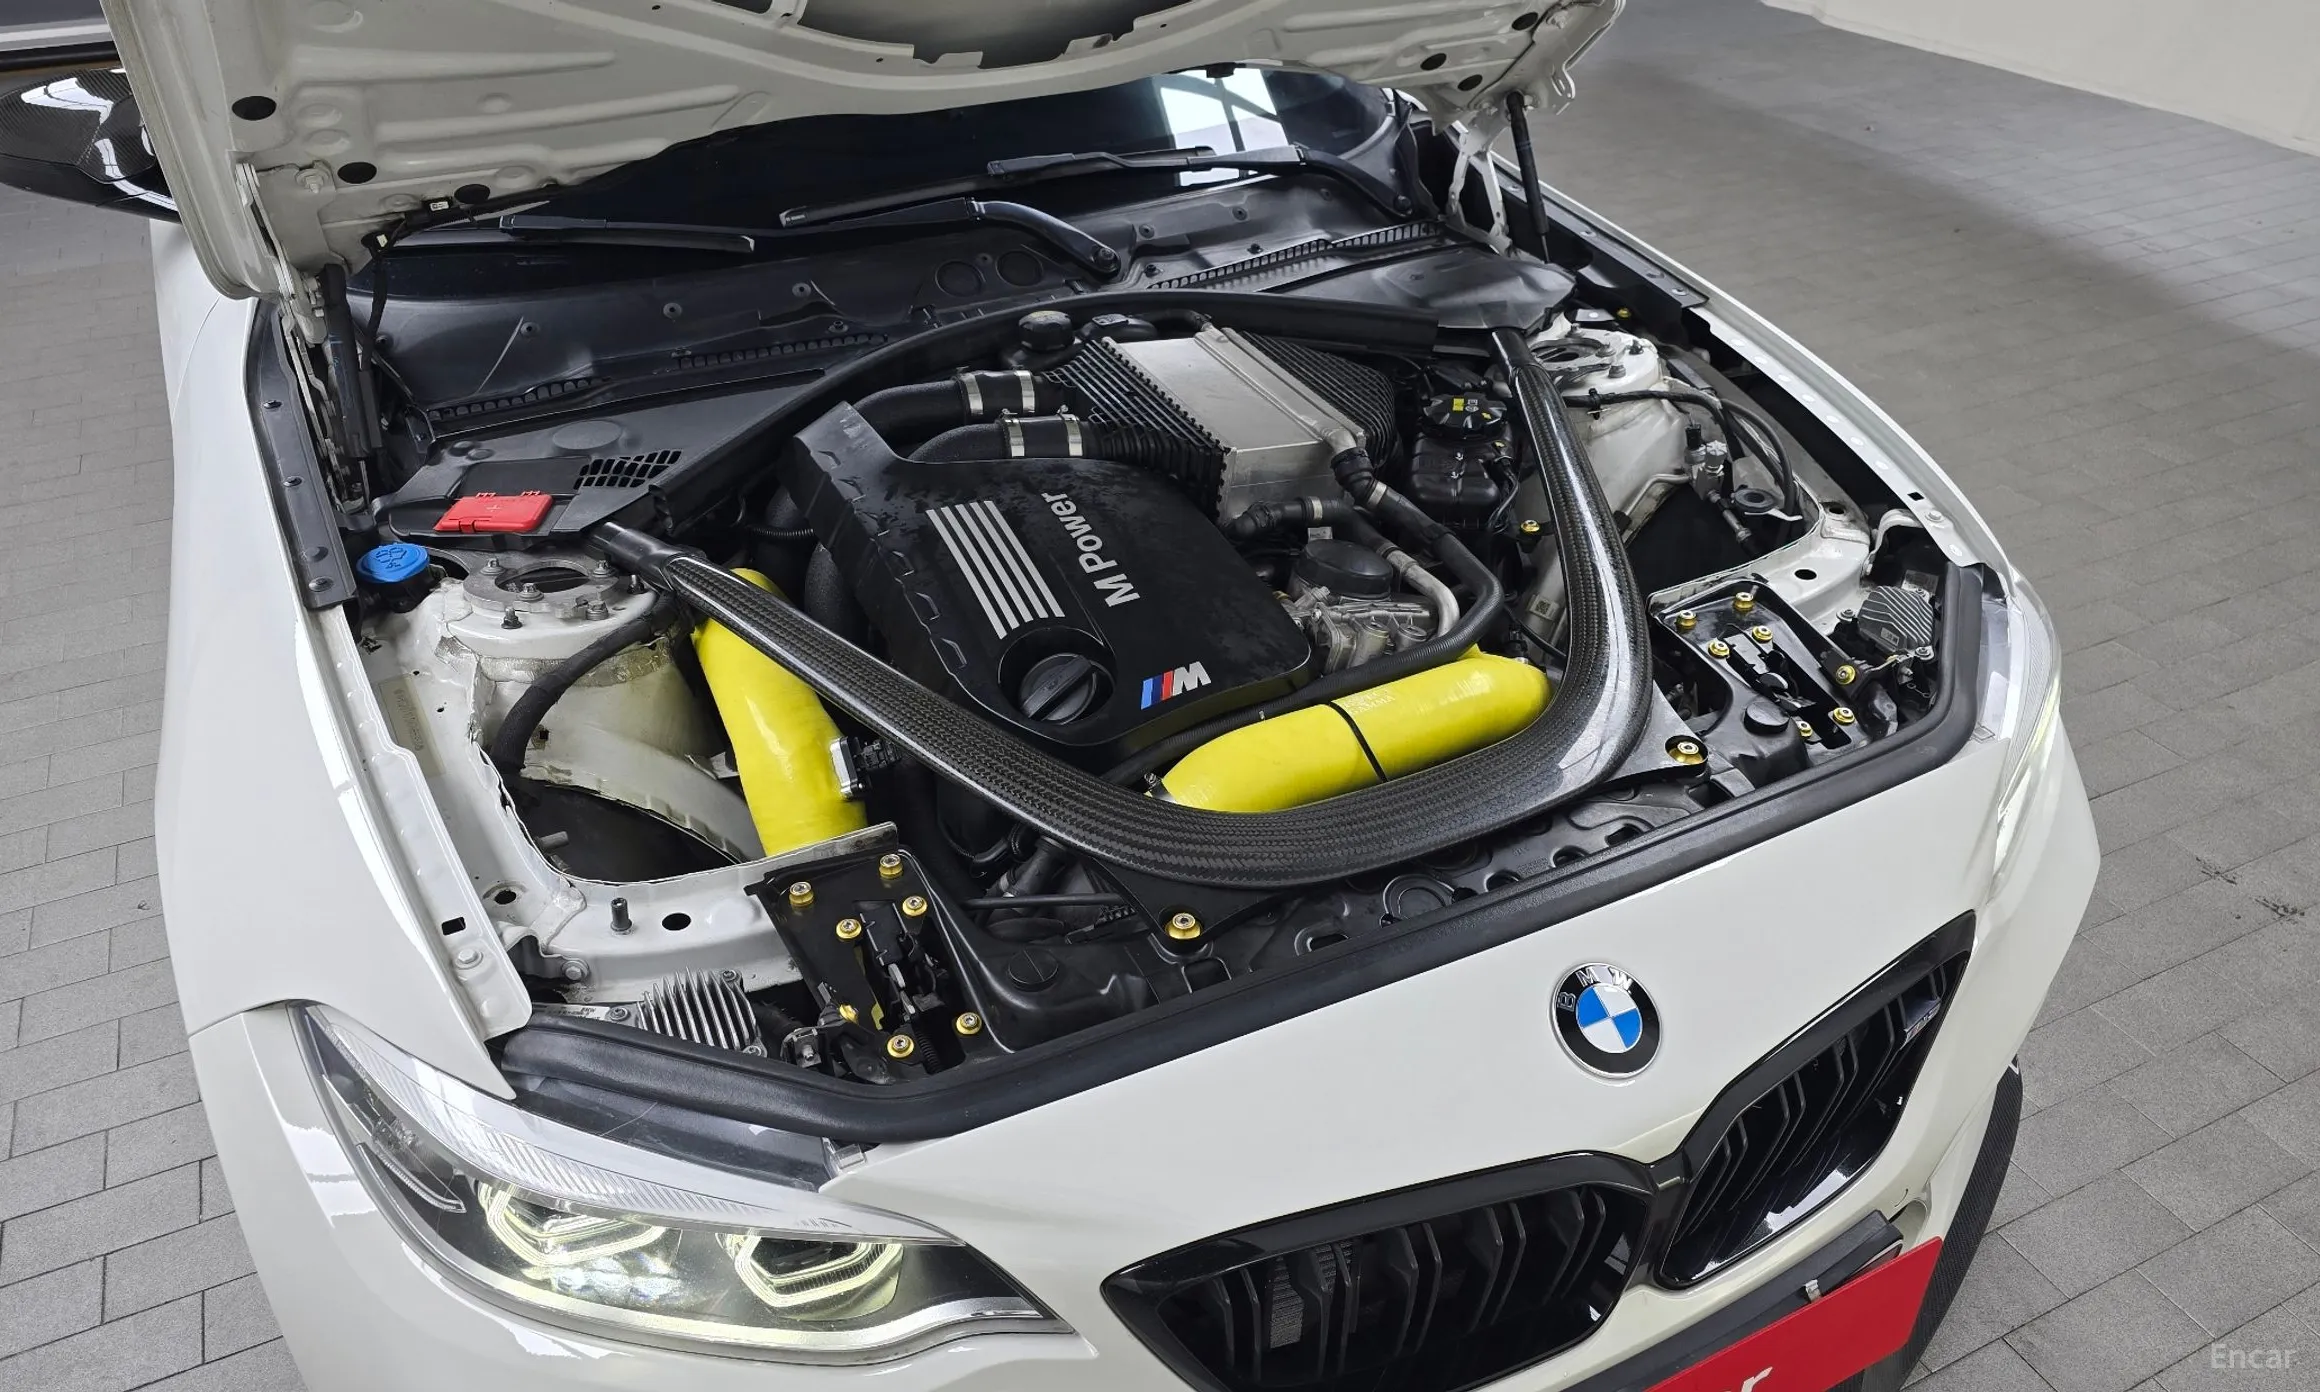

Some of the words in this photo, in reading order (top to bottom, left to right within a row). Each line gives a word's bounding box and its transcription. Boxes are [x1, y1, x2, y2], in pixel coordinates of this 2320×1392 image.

[1041, 492, 1118, 574] Power
[1093, 573, 1141, 607] M
[1557, 965, 1633, 1013] BMW
